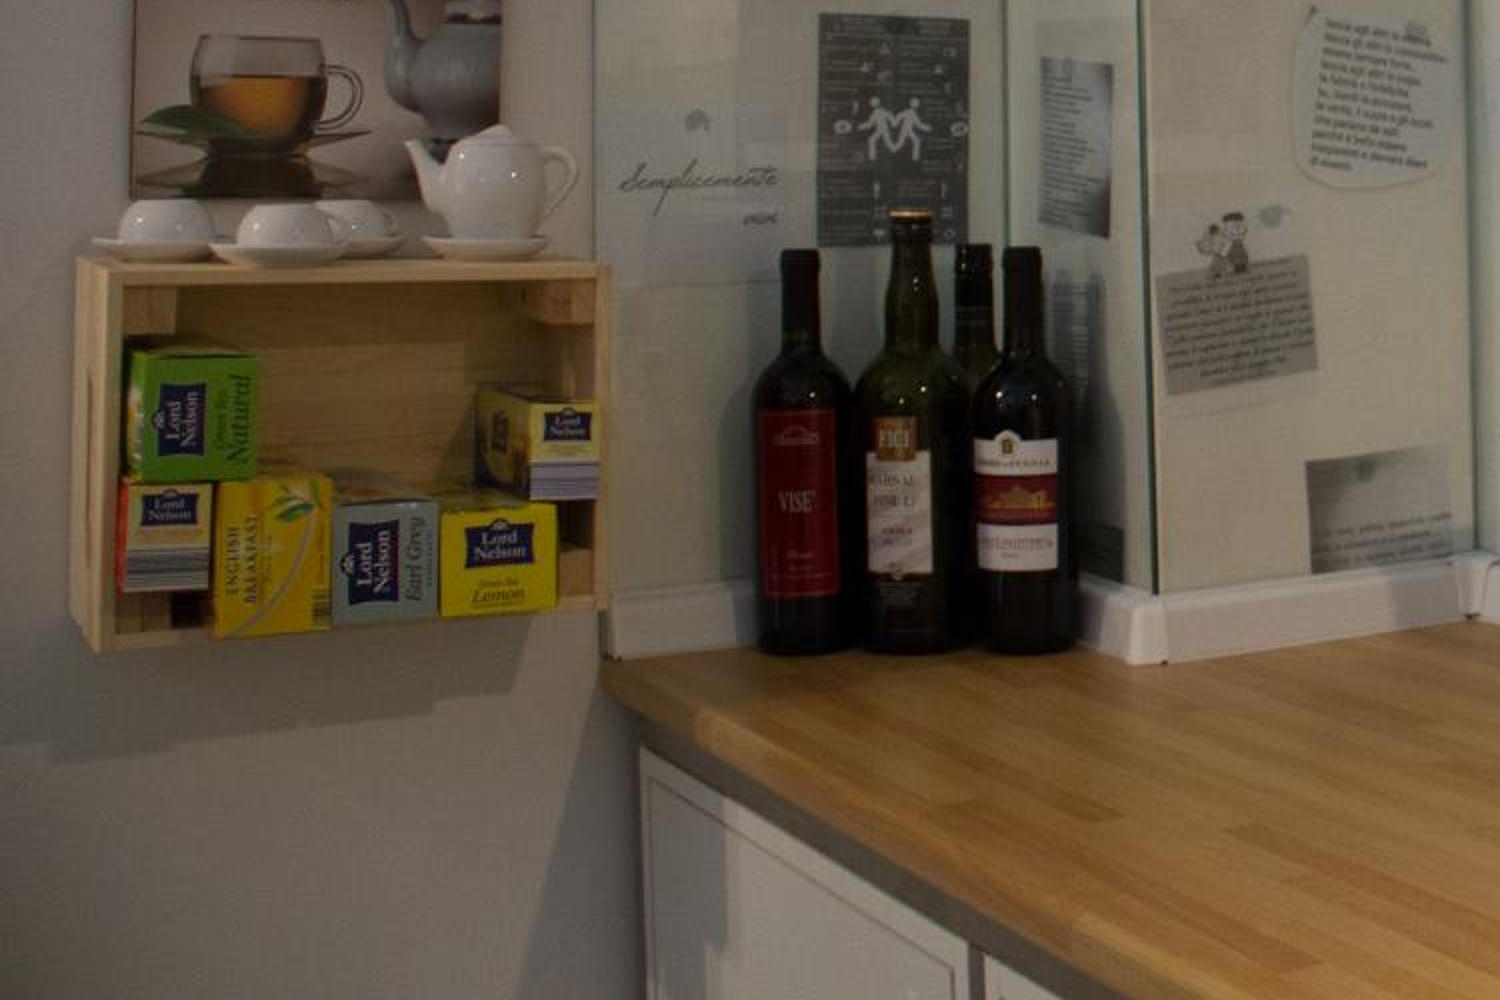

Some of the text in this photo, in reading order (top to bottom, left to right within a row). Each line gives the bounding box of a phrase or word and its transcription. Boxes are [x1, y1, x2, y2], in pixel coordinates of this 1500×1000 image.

[163, 401, 182, 440] Lord
[180, 391, 200, 447] Nelson
[406, 516, 425, 560] Grey
[474, 545, 527, 561] Nelson
[480, 530, 518, 546] Lord
[224, 526, 241, 596] ENGLISH
[355, 541, 373, 586] Lord
[372, 529, 392, 594] Nelson
